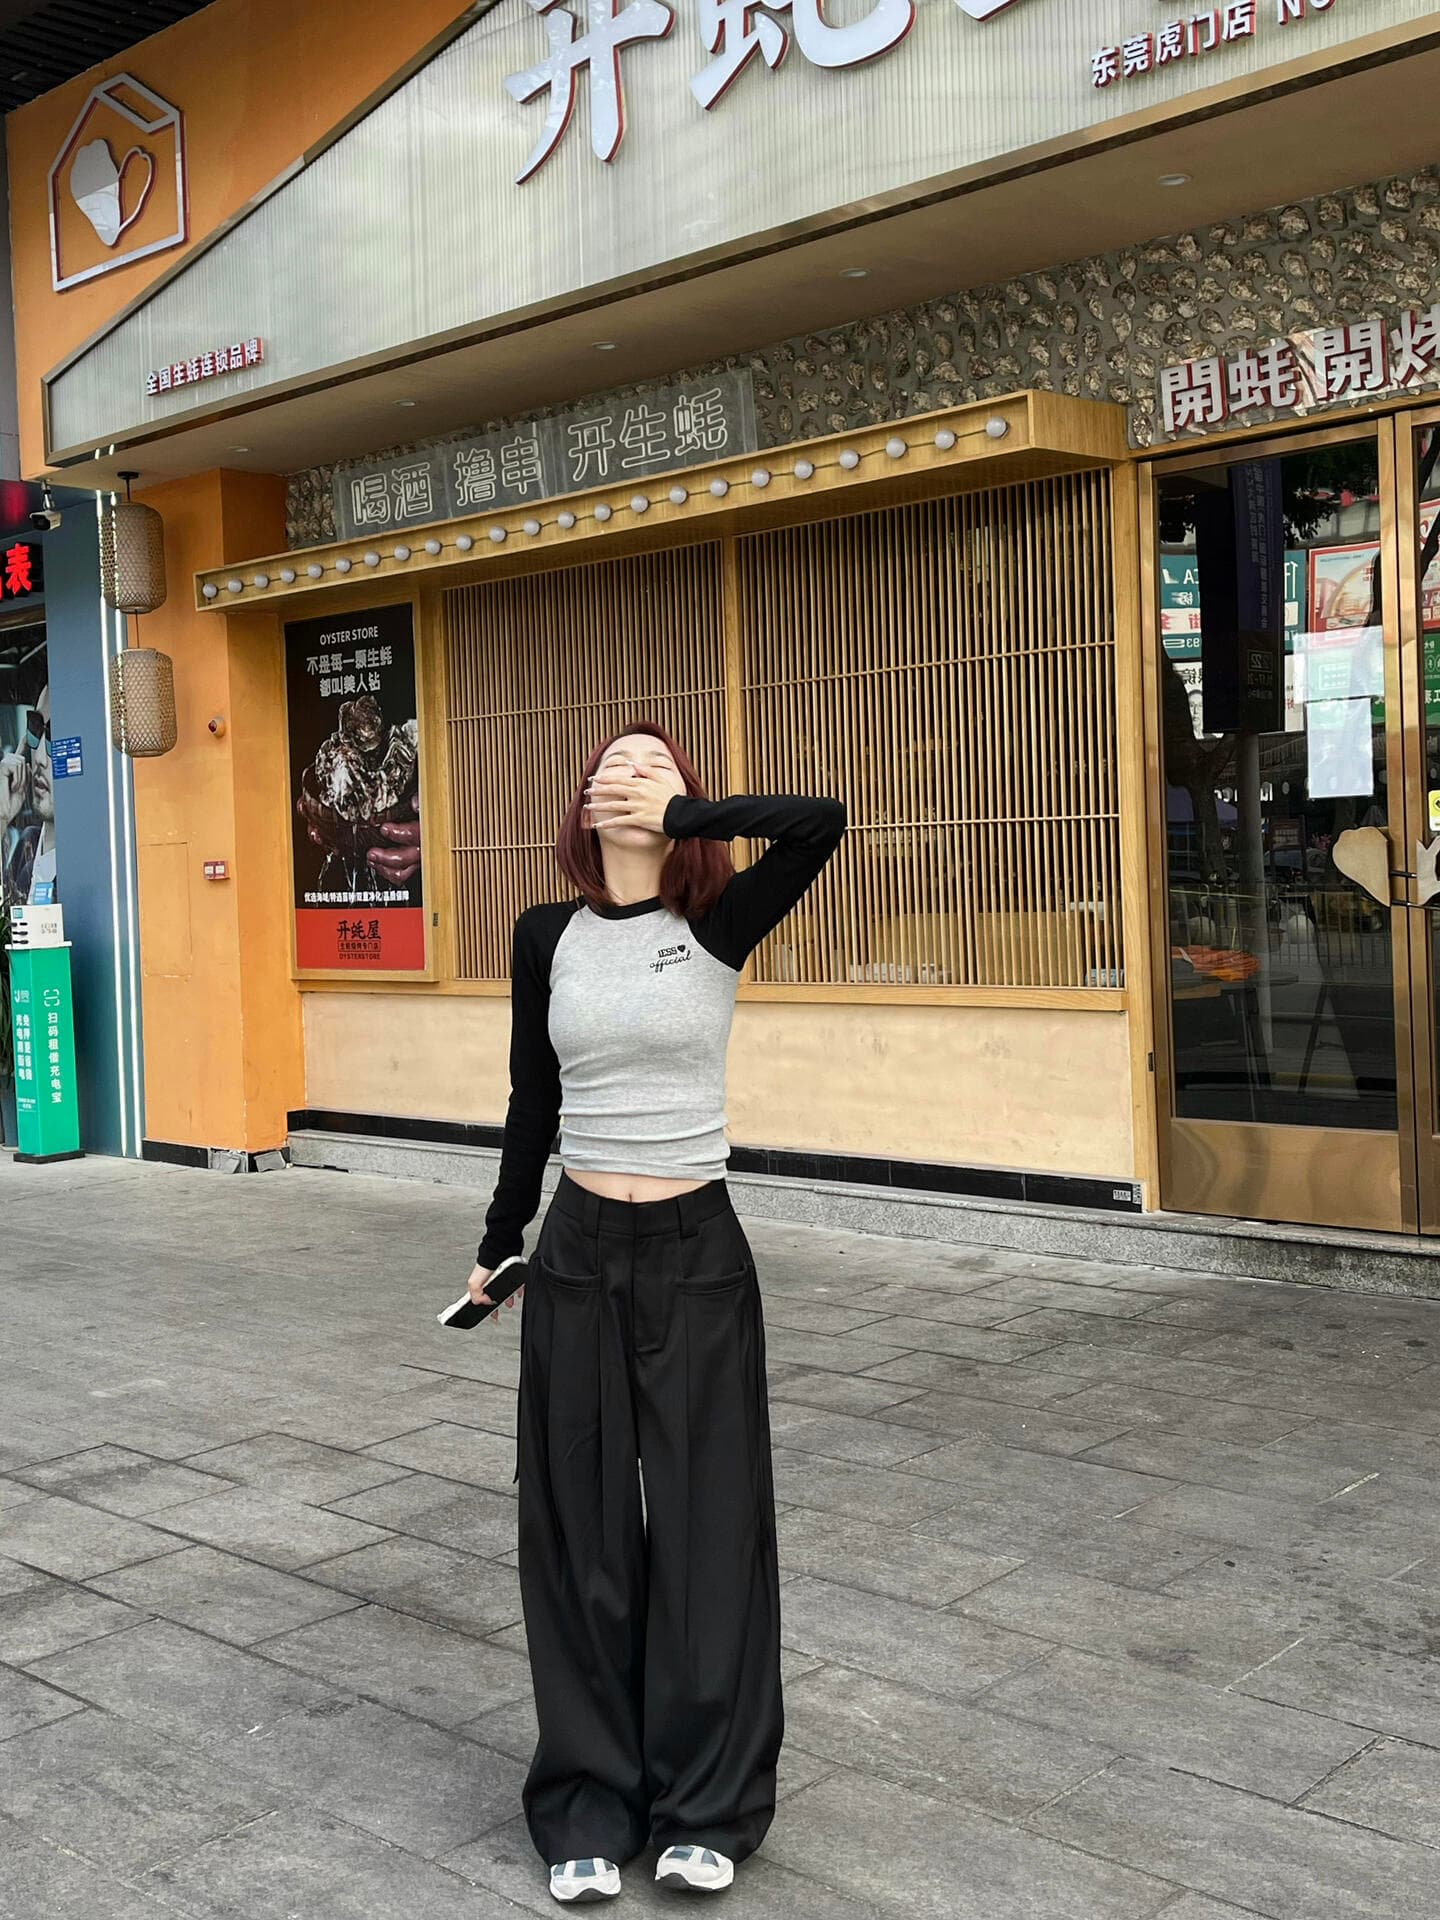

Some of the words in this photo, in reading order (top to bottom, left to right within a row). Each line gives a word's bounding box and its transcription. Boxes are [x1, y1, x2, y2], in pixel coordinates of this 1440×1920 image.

[1091, 0, 1257, 88] 东莞虎门店
[145, 337, 263, 396] 全国生蚝连锁品牌
[352, 462, 434, 527] 喝酒
[454, 437, 543, 507] 撸串
[567, 388, 729, 482] 开生蚝
[320, 630, 350, 645] OYSTER
[351, 626, 379, 641] STORE
[320, 671, 381, 697] 都叫美人钻
[336, 919, 382, 940] 开蚝屋
[649, 949, 691, 973] official
[47, 1012, 62, 1104] 扫码租借充电宝
